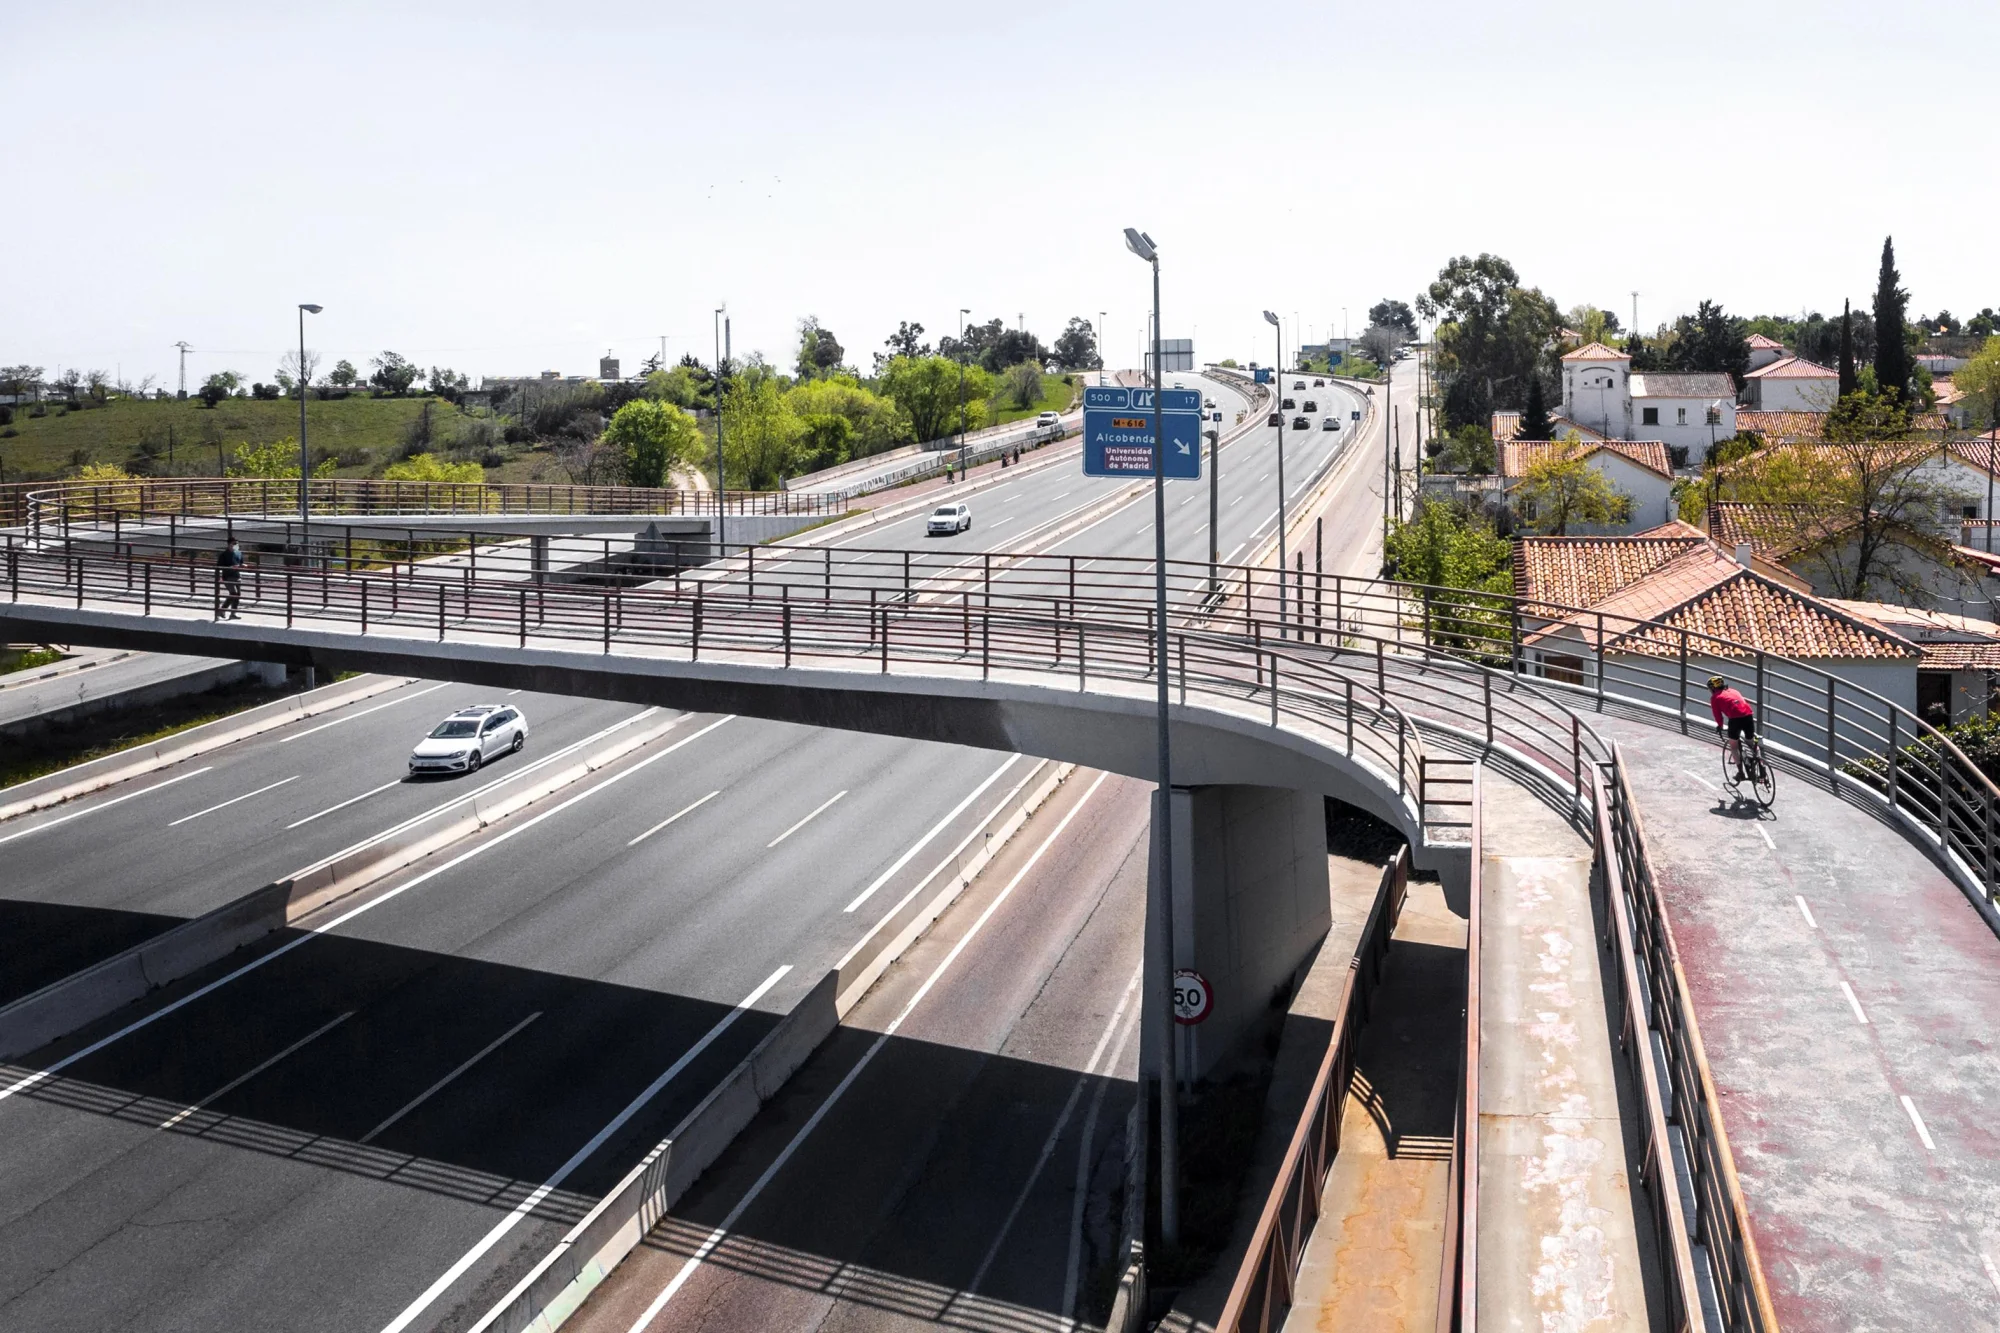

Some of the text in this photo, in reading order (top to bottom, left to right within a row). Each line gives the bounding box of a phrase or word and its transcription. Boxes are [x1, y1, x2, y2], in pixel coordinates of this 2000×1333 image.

[1091, 394, 1110, 402] 500
[1113, 420, 1144, 428] M-616
[1096, 433, 1155, 444] Alcobenda
[1105, 447, 1152, 455] Universidad
[1174, 988, 1200, 1006] 50
